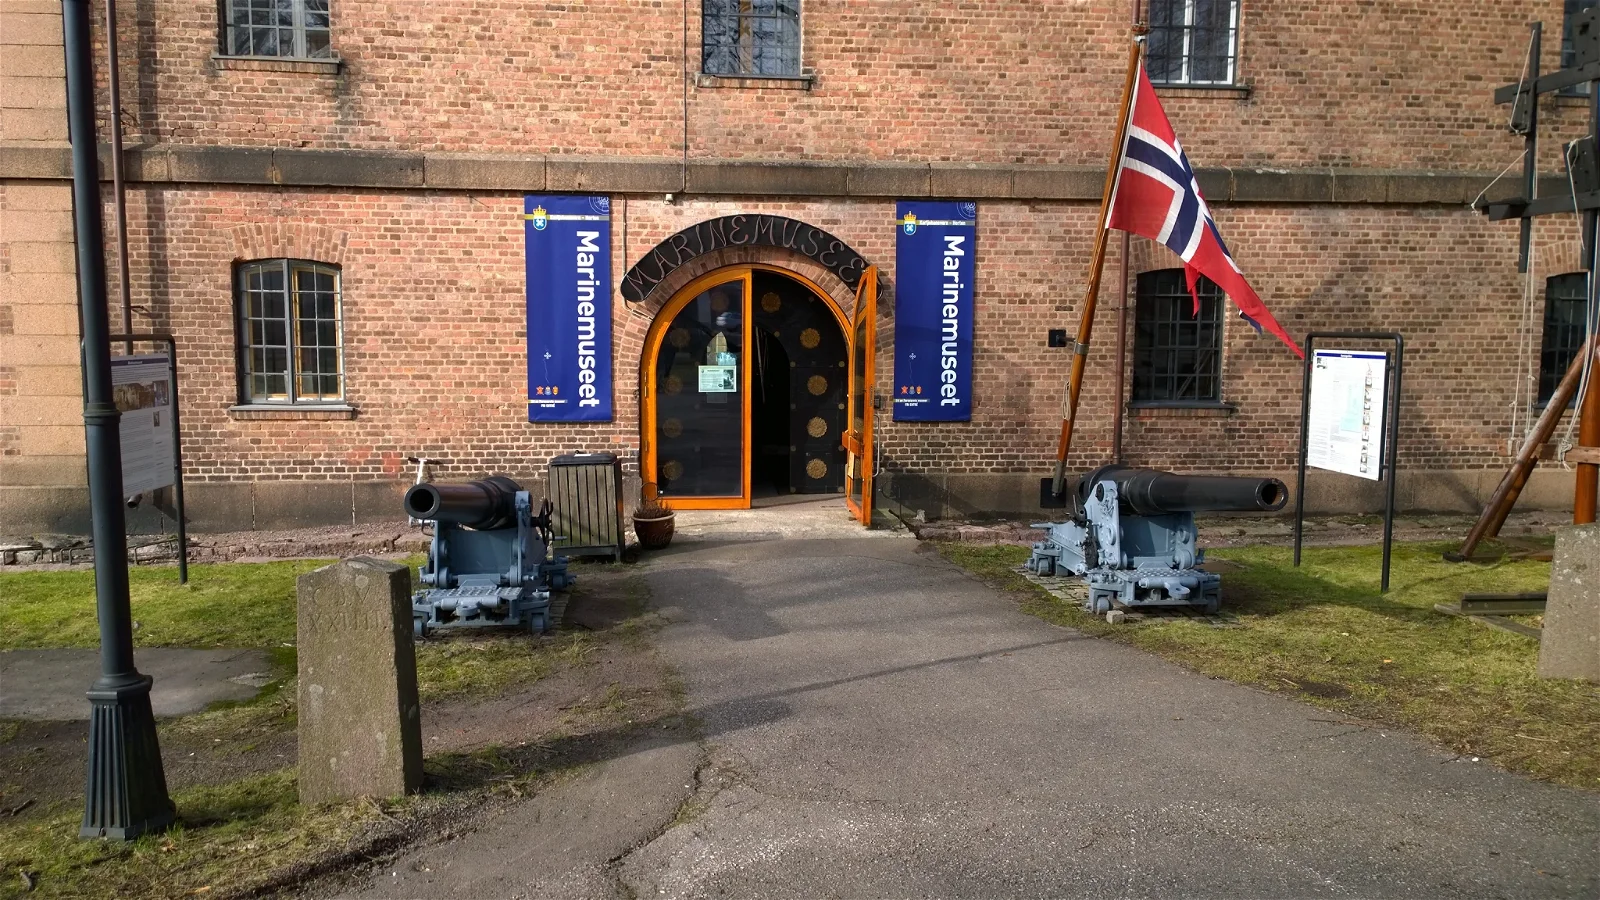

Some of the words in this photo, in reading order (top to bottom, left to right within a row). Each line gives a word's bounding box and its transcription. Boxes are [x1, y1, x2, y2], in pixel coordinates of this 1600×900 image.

[576, 230, 600, 408] Marinemuseet
[626, 214, 880, 302] MARINEMUSEE
[940, 235, 966, 407] Marinemuseet
